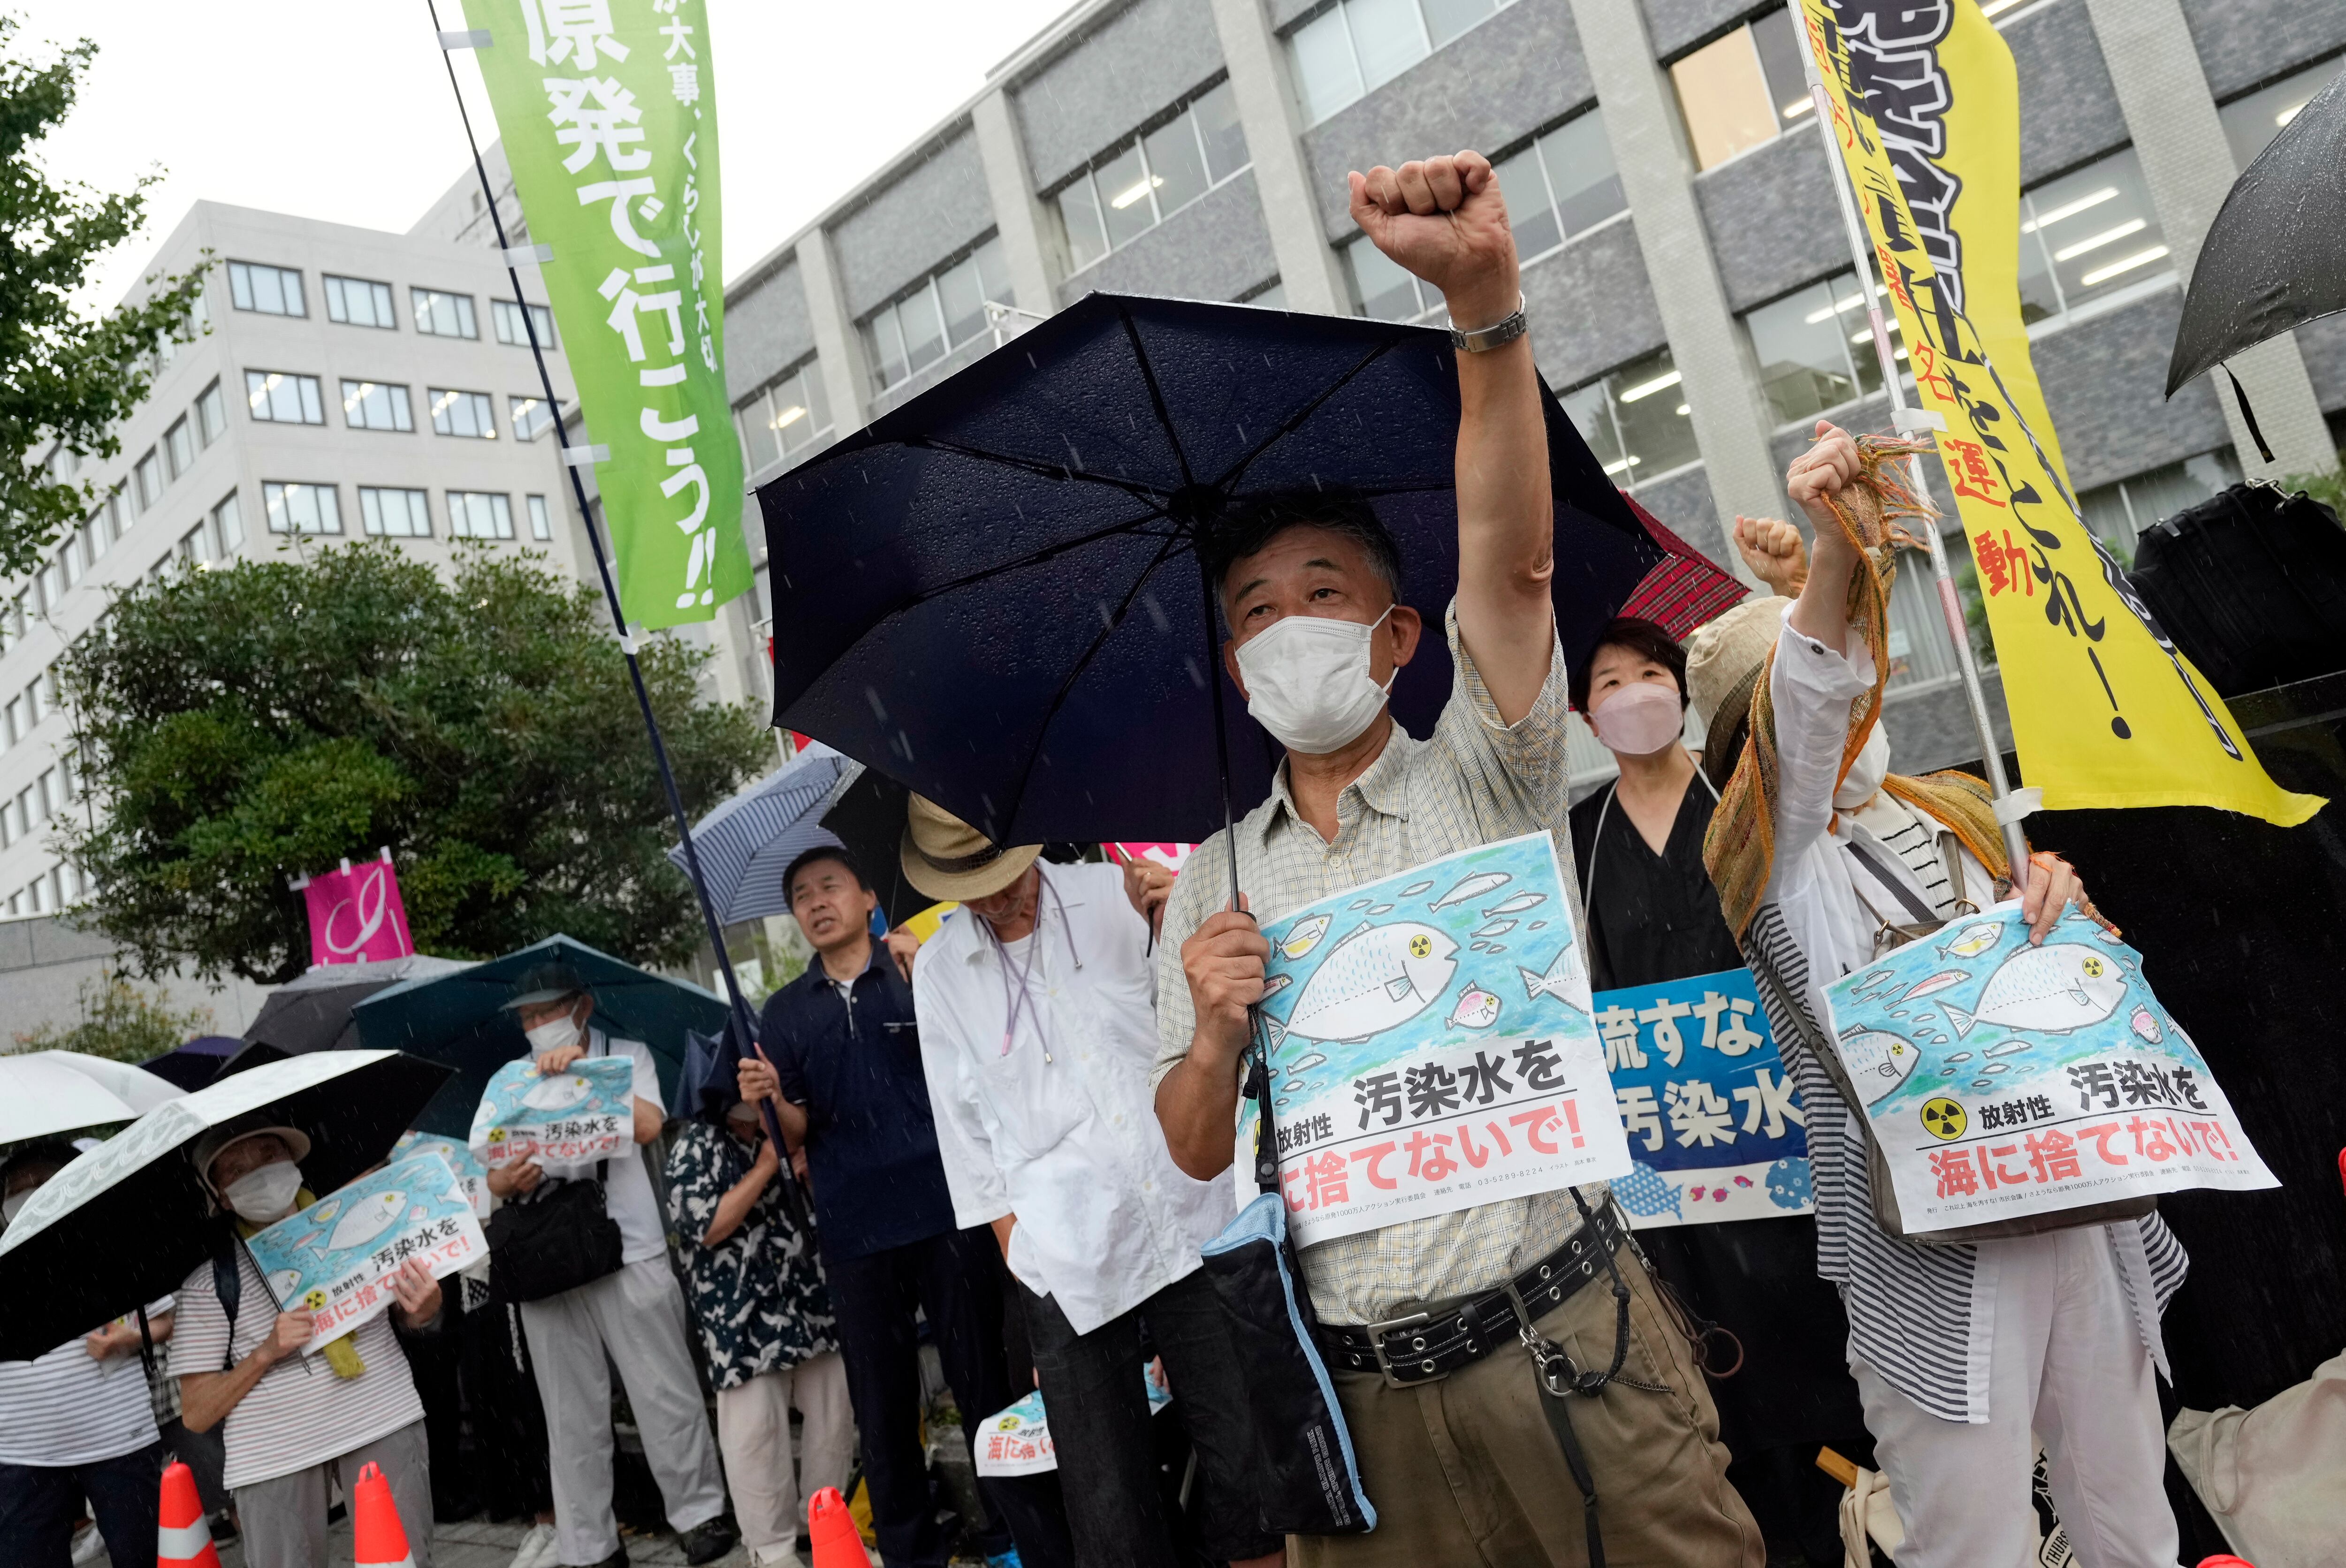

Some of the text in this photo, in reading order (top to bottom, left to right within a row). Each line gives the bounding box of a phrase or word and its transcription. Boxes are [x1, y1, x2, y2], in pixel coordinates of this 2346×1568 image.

[1596, 991, 1777, 1073] 流すな
[1277, 1040, 1566, 1154] 放射性 汚染水を
[1978, 1060, 2208, 1130] 放射性 汚染水を
[545, 1117, 618, 1141] 汚染水を
[1433, 1186, 1453, 1196] 連絡先
[1458, 1182, 1471, 1190] 電話
[1478, 1167, 1544, 1186] 03-5289-8224
[1549, 1162, 1569, 1171] イラスト
[1925, 1116, 2239, 1200] 海に捨てないで!
[371, 1218, 459, 1272] 汚染水を
[314, 1235, 471, 1336] 海に捨ていで!
[1307, 1429, 1319, 1455] PARK
[1315, 1425, 1329, 1459] GROUND
[1324, 1457, 1340, 1492] SPORTS
